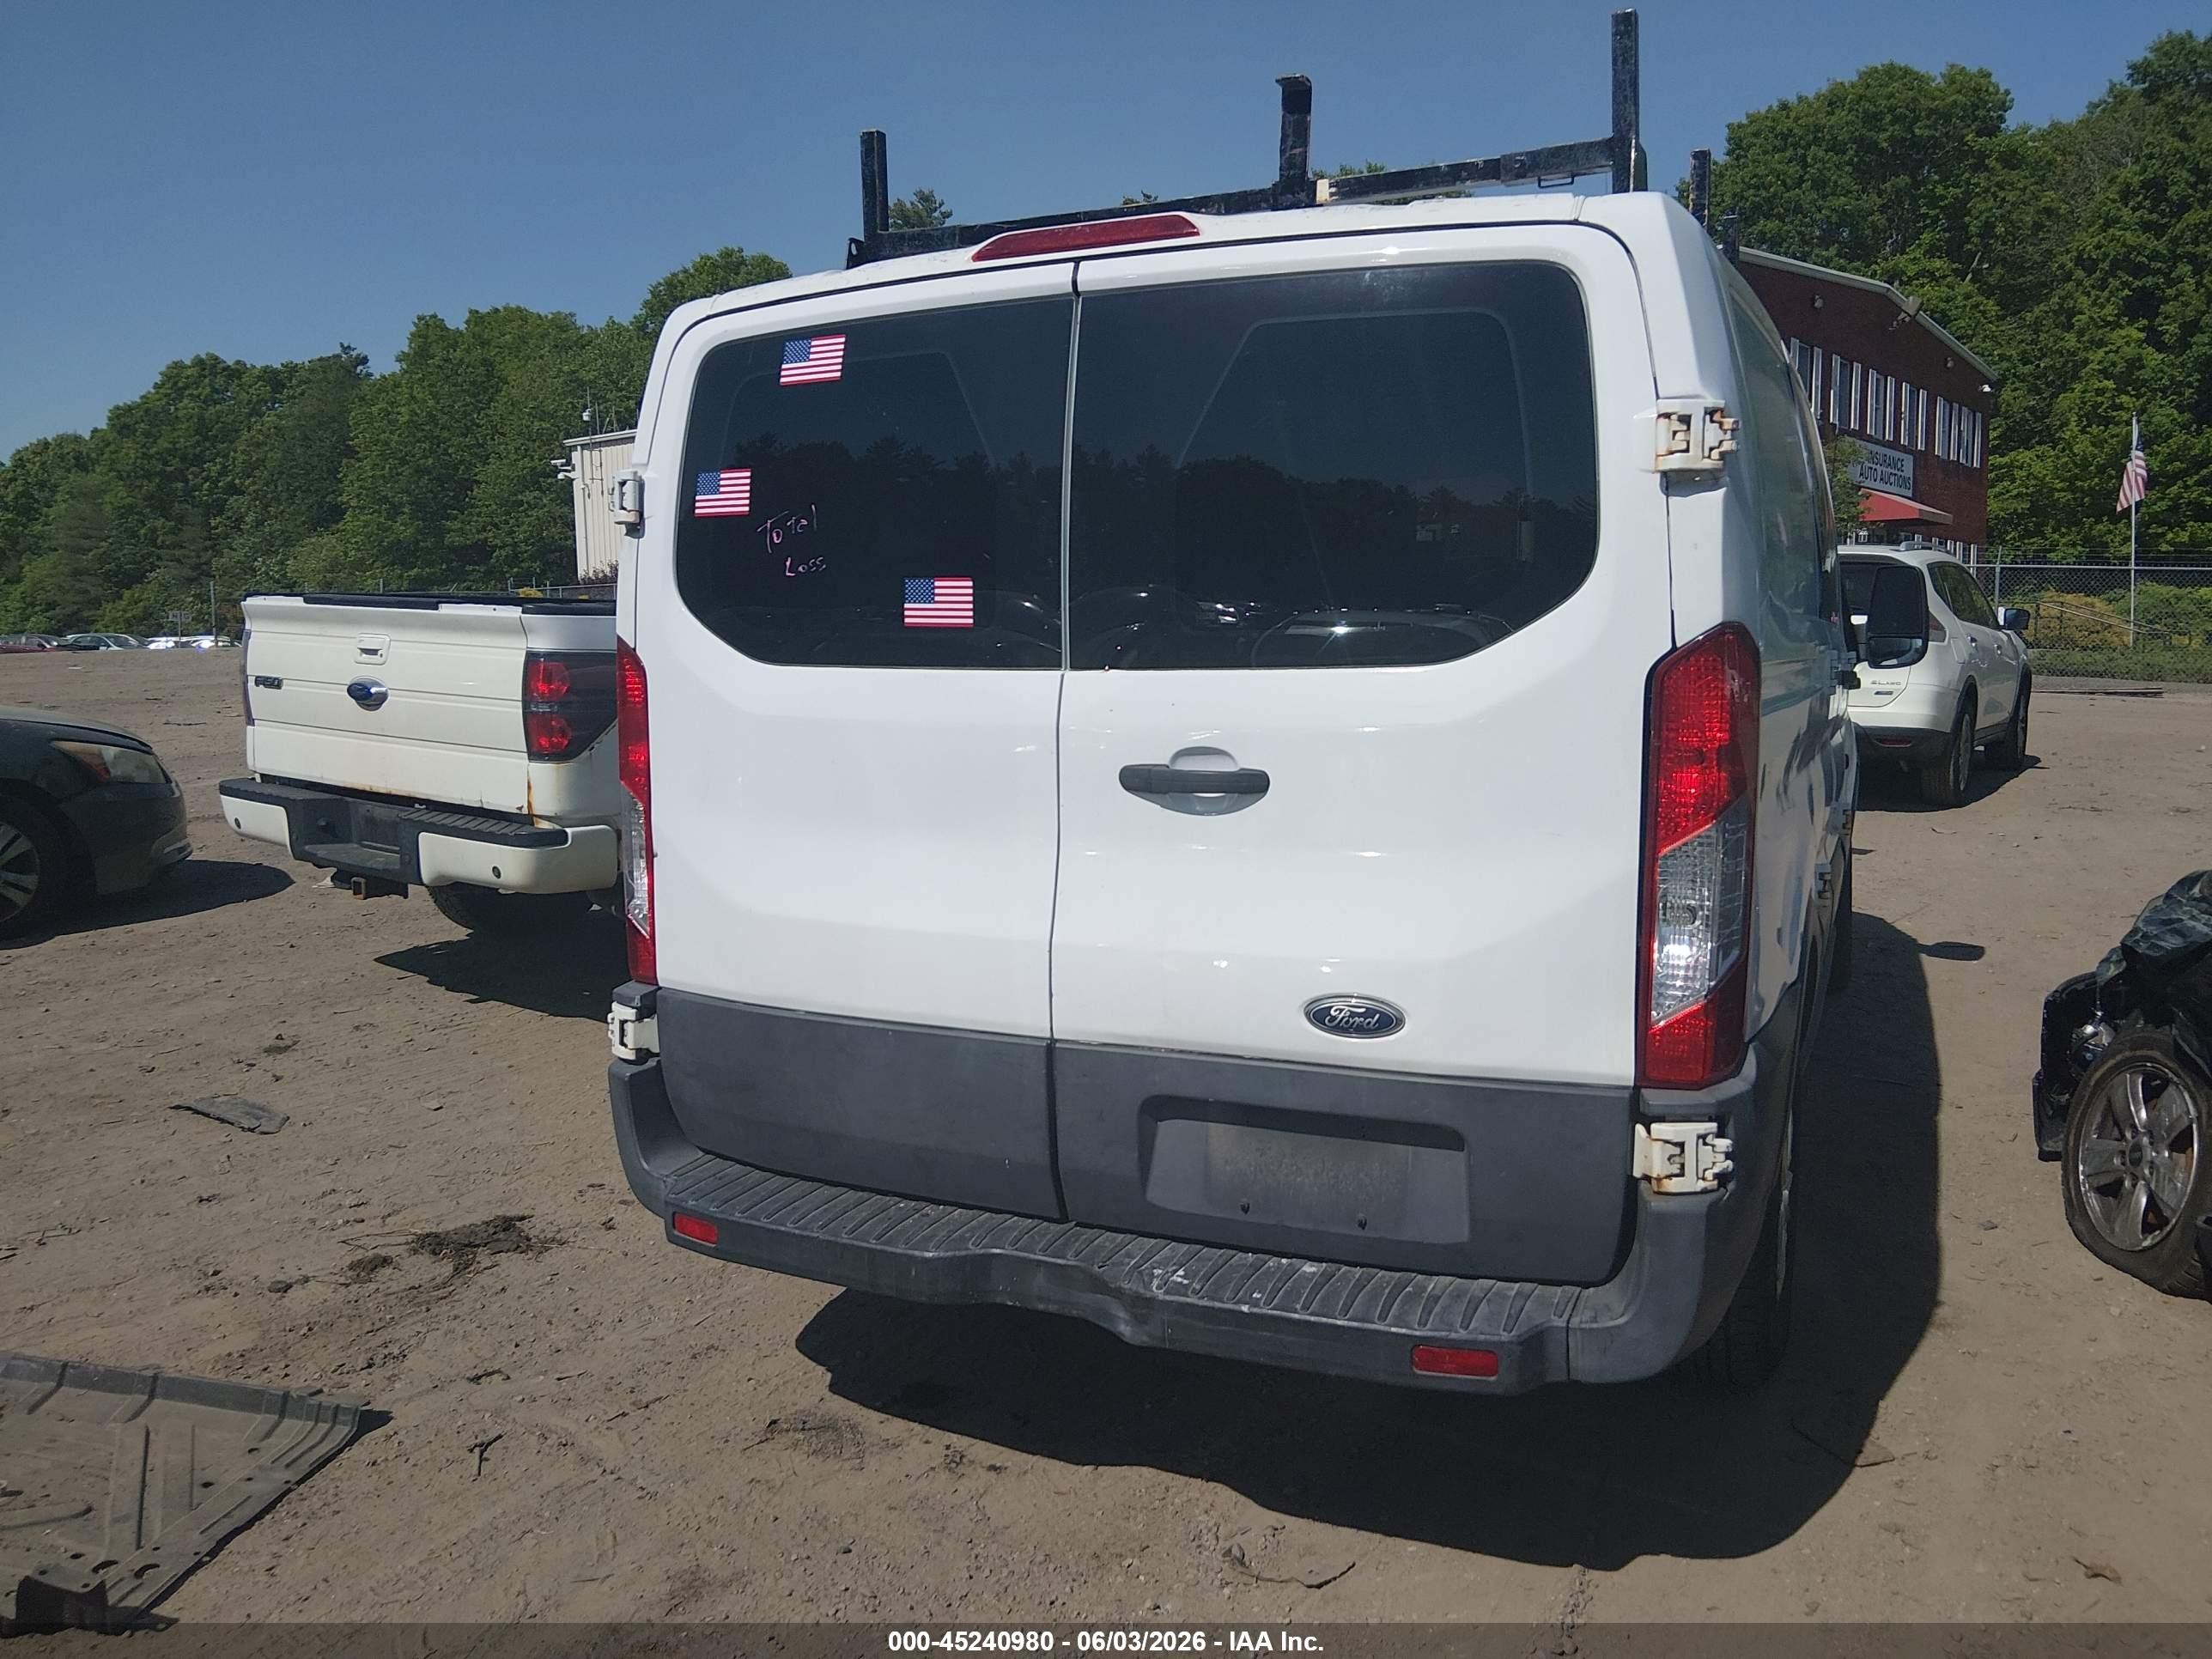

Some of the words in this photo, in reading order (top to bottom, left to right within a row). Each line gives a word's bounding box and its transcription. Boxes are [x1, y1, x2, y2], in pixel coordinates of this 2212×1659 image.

[1859, 463, 1878, 483] AUTO
[1879, 470, 1911, 490] AUCTIONS
[757, 504, 817, 553] Total
[785, 556, 827, 576] Loss
[1324, 1004, 1381, 1030] Ford
